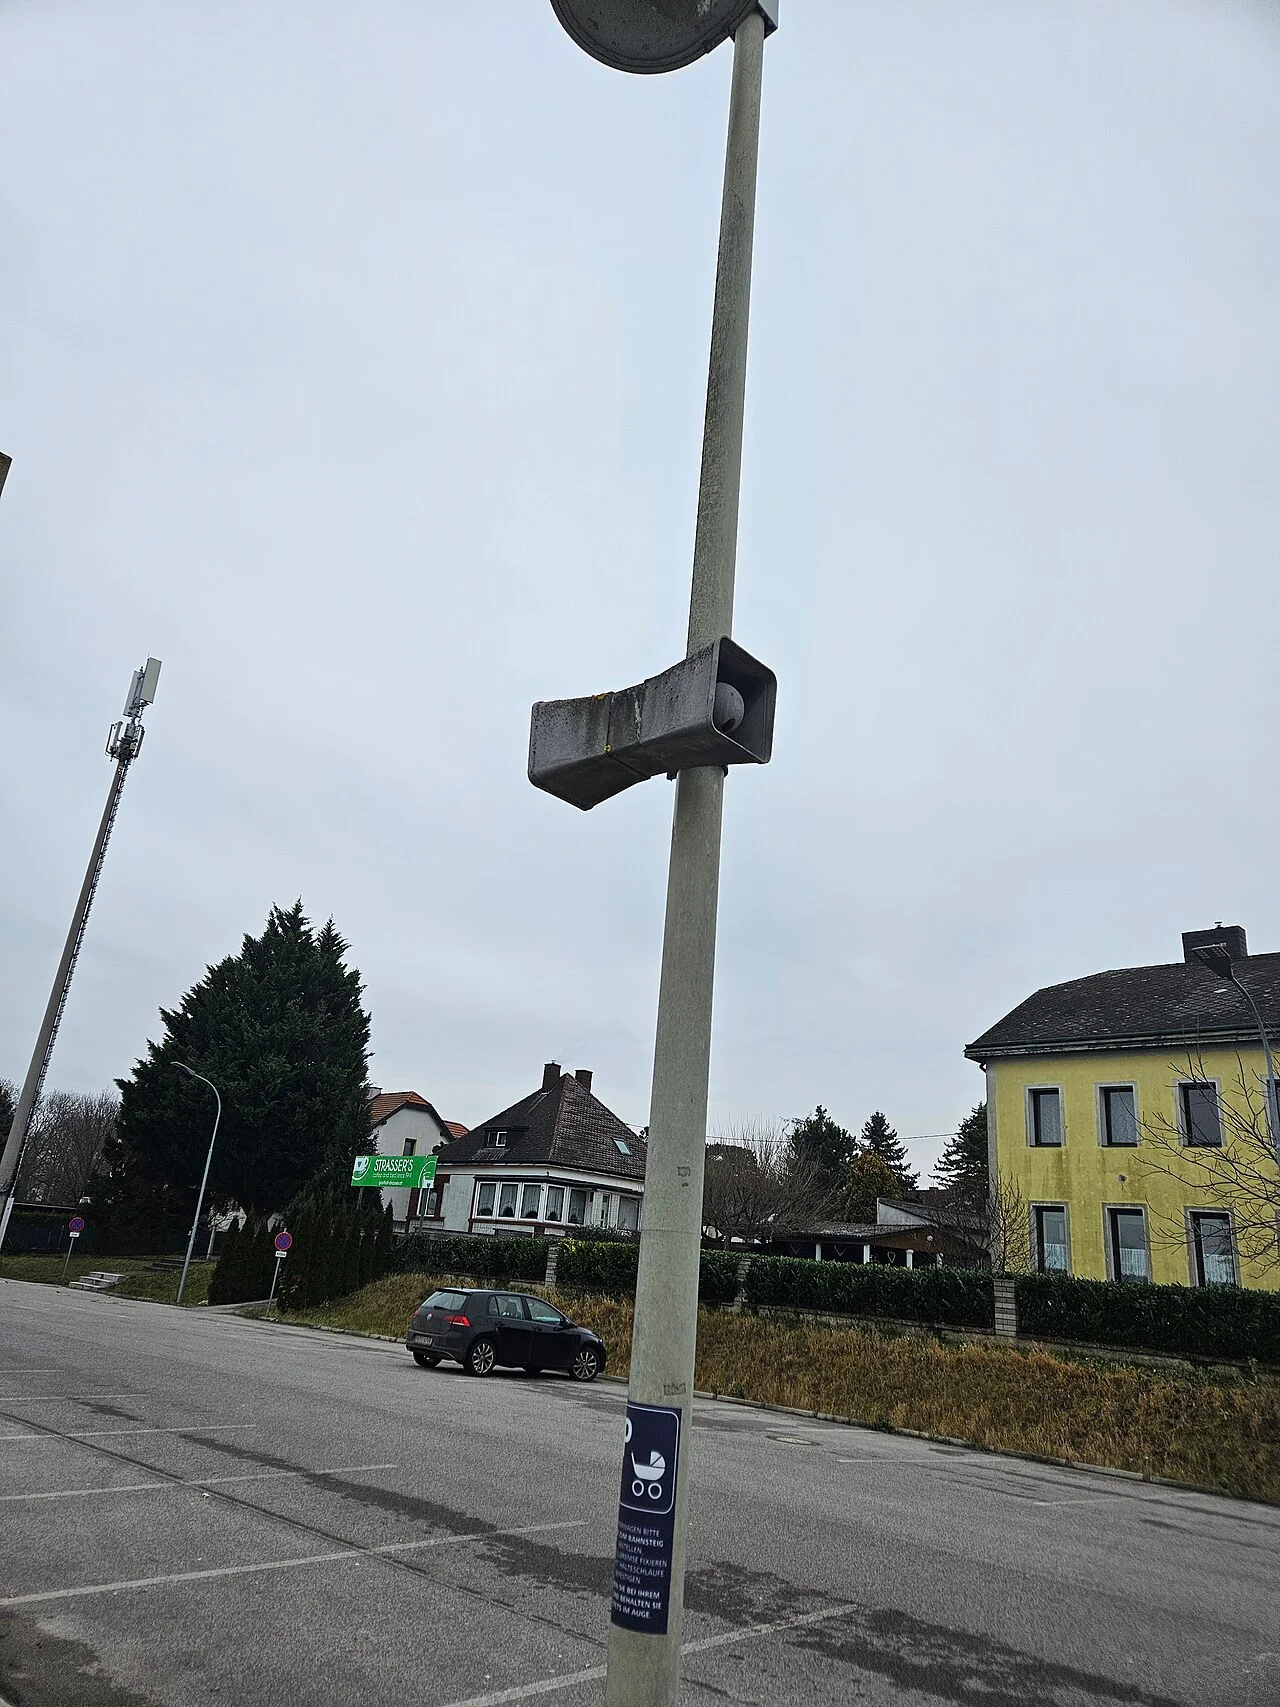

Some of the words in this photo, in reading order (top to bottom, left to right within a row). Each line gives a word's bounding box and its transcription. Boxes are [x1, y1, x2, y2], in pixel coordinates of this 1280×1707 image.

[374, 1159, 413, 1171] STRASSER'S
[643, 1528, 660, 1537] BITTE
[628, 1535, 664, 1547] BAHNSTEIG
[627, 1587, 636, 1596] BEI
[638, 1590, 660, 1599] IHREM
[620, 1595, 650, 1608] BEHALTEN
[652, 1601, 662, 1610] SIE
[623, 1606, 630, 1614] IM
